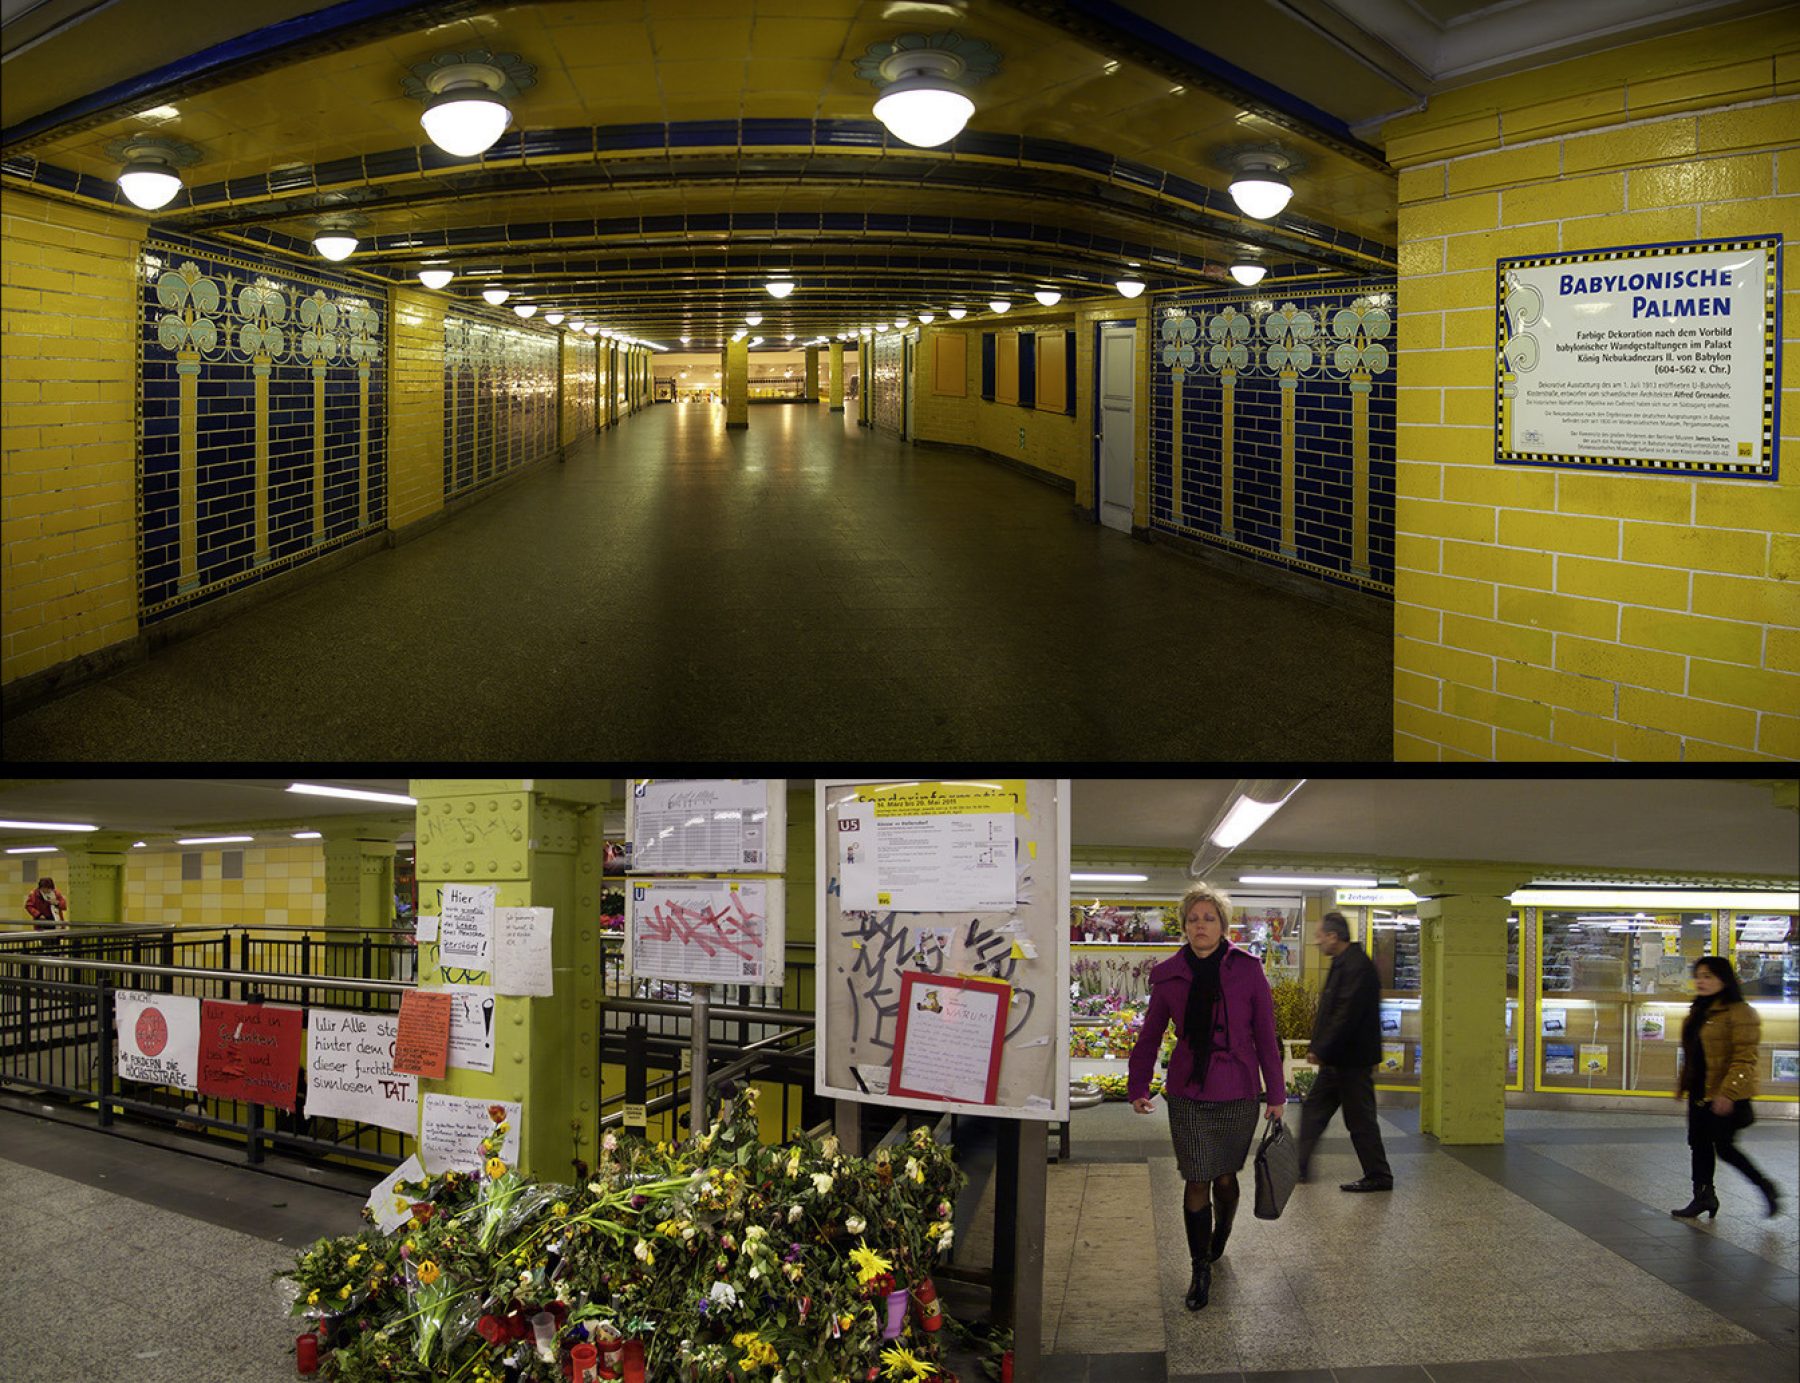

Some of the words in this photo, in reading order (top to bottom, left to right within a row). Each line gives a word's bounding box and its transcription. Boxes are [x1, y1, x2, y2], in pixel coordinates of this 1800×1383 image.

[1559, 269, 1732, 295] BABYLONISCHE
[1633, 296, 1731, 318] PALMEN
[1577, 331, 1606, 340] Farbige
[1608, 329, 1652, 339] Dekoration
[1655, 327, 1675, 337] nach
[1678, 327, 1696, 337] dem
[1699, 327, 1732, 337] Vorbild
[1556, 342, 1608, 352] babylonischer
[1610, 340, 1688, 352] Wandgestaltungen
[1690, 341, 1702, 349] im
[1704, 340, 1732, 349] Palast
[1577, 353, 1600, 364] König
[1602, 353, 1664, 362] Nebukadnezars
[1677, 354, 1692, 362] von
[1695, 352, 1731, 363] Babylon
[1708, 364, 1731, 375] Chr.)
[840, 820, 858, 832] U5
[451, 889, 474, 904] Hier
[315, 1016, 336, 1032] Wir
[341, 1017, 368, 1033] Alle
[376, 1020, 397, 1038] ste
[315, 1036, 352, 1052] hinter
[356, 1038, 383, 1055] dem
[313, 1056, 348, 1073] dieser
